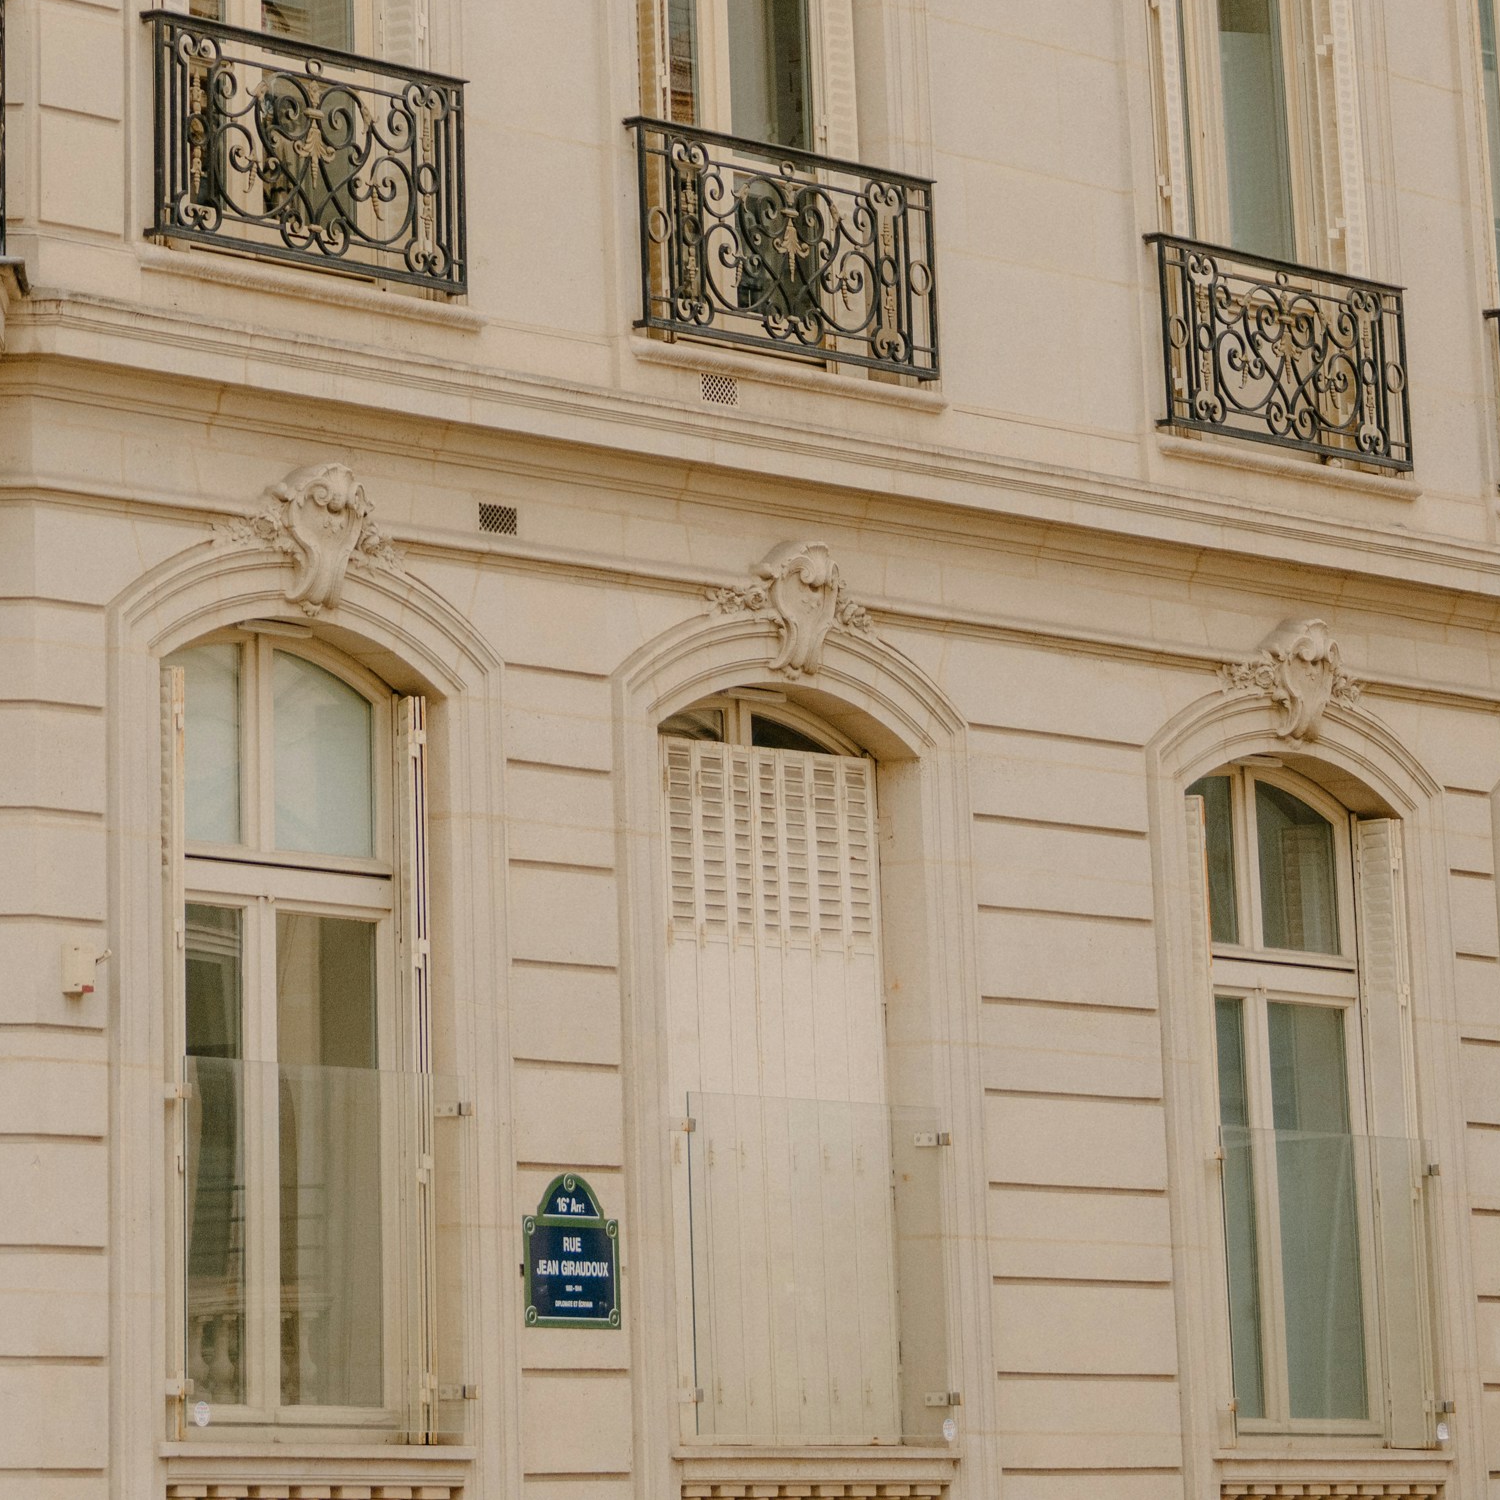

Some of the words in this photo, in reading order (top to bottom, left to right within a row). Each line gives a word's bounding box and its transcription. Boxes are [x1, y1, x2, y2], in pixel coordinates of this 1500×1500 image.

[563, 1237, 582, 1252] RUE
[536, 1259, 559, 1276] JEAN
[560, 1260, 609, 1277] GIRAUDOUX
